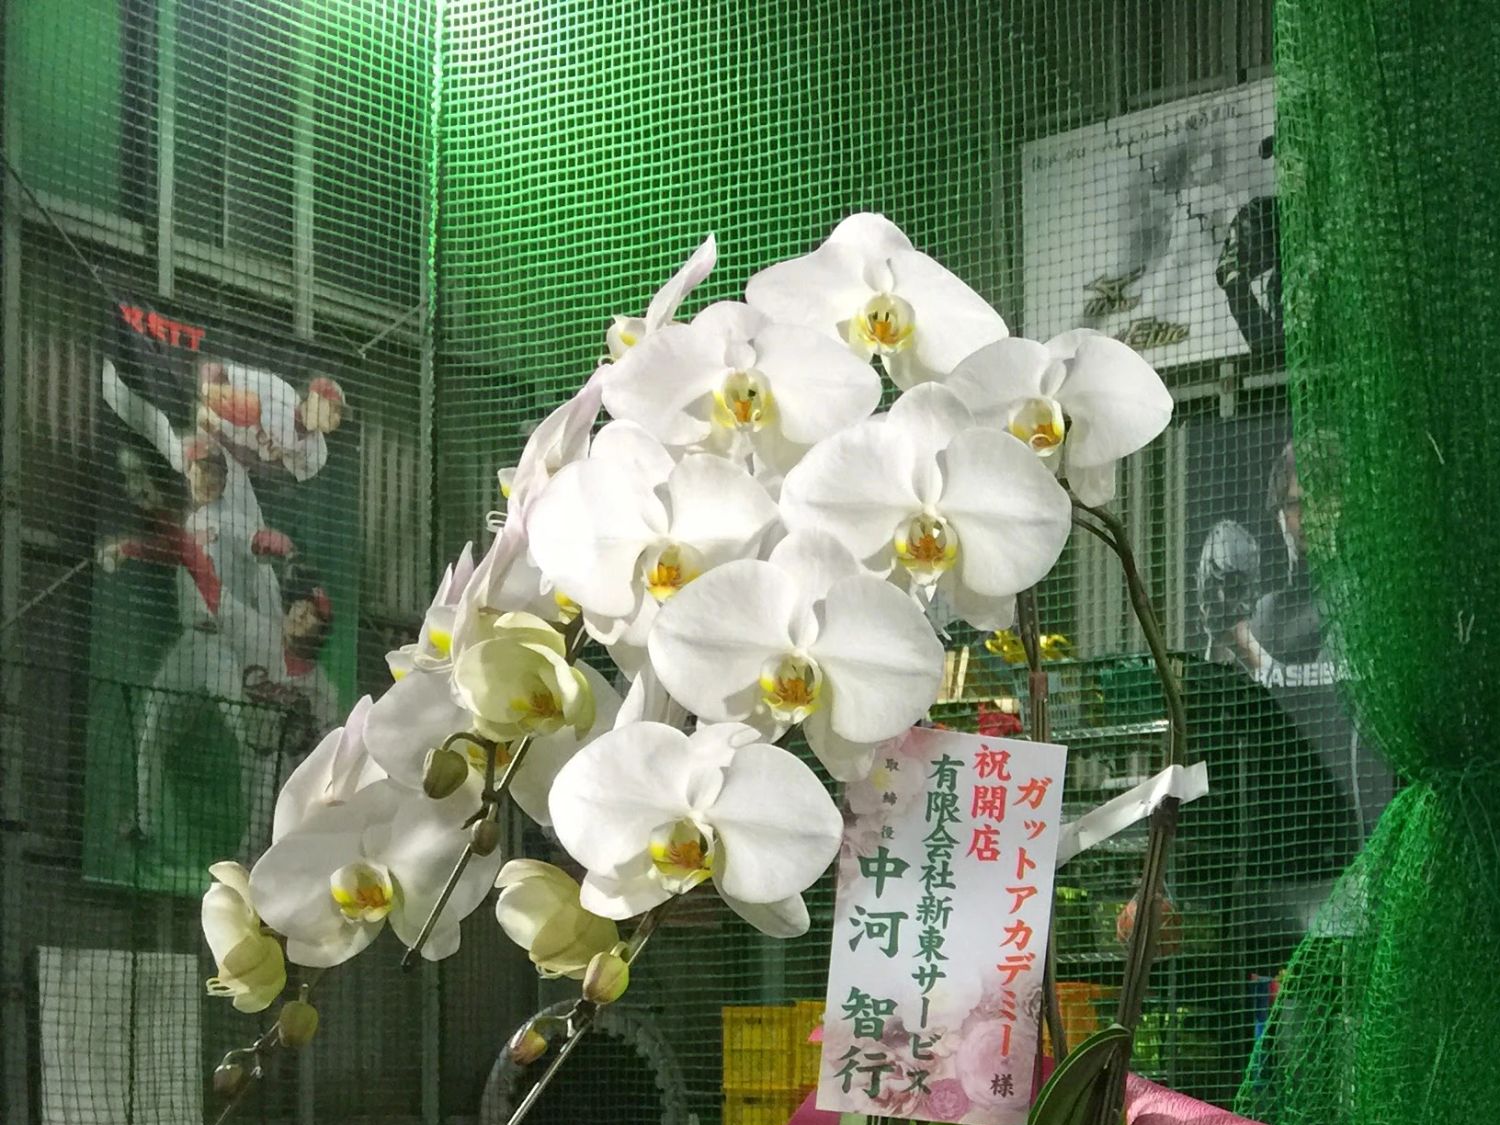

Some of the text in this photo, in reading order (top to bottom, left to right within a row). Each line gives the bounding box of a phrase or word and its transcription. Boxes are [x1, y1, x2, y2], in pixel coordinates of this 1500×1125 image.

[966, 744, 1012, 862] 祝開店
[901, 753, 965, 1095] 有限会社新東サービス
